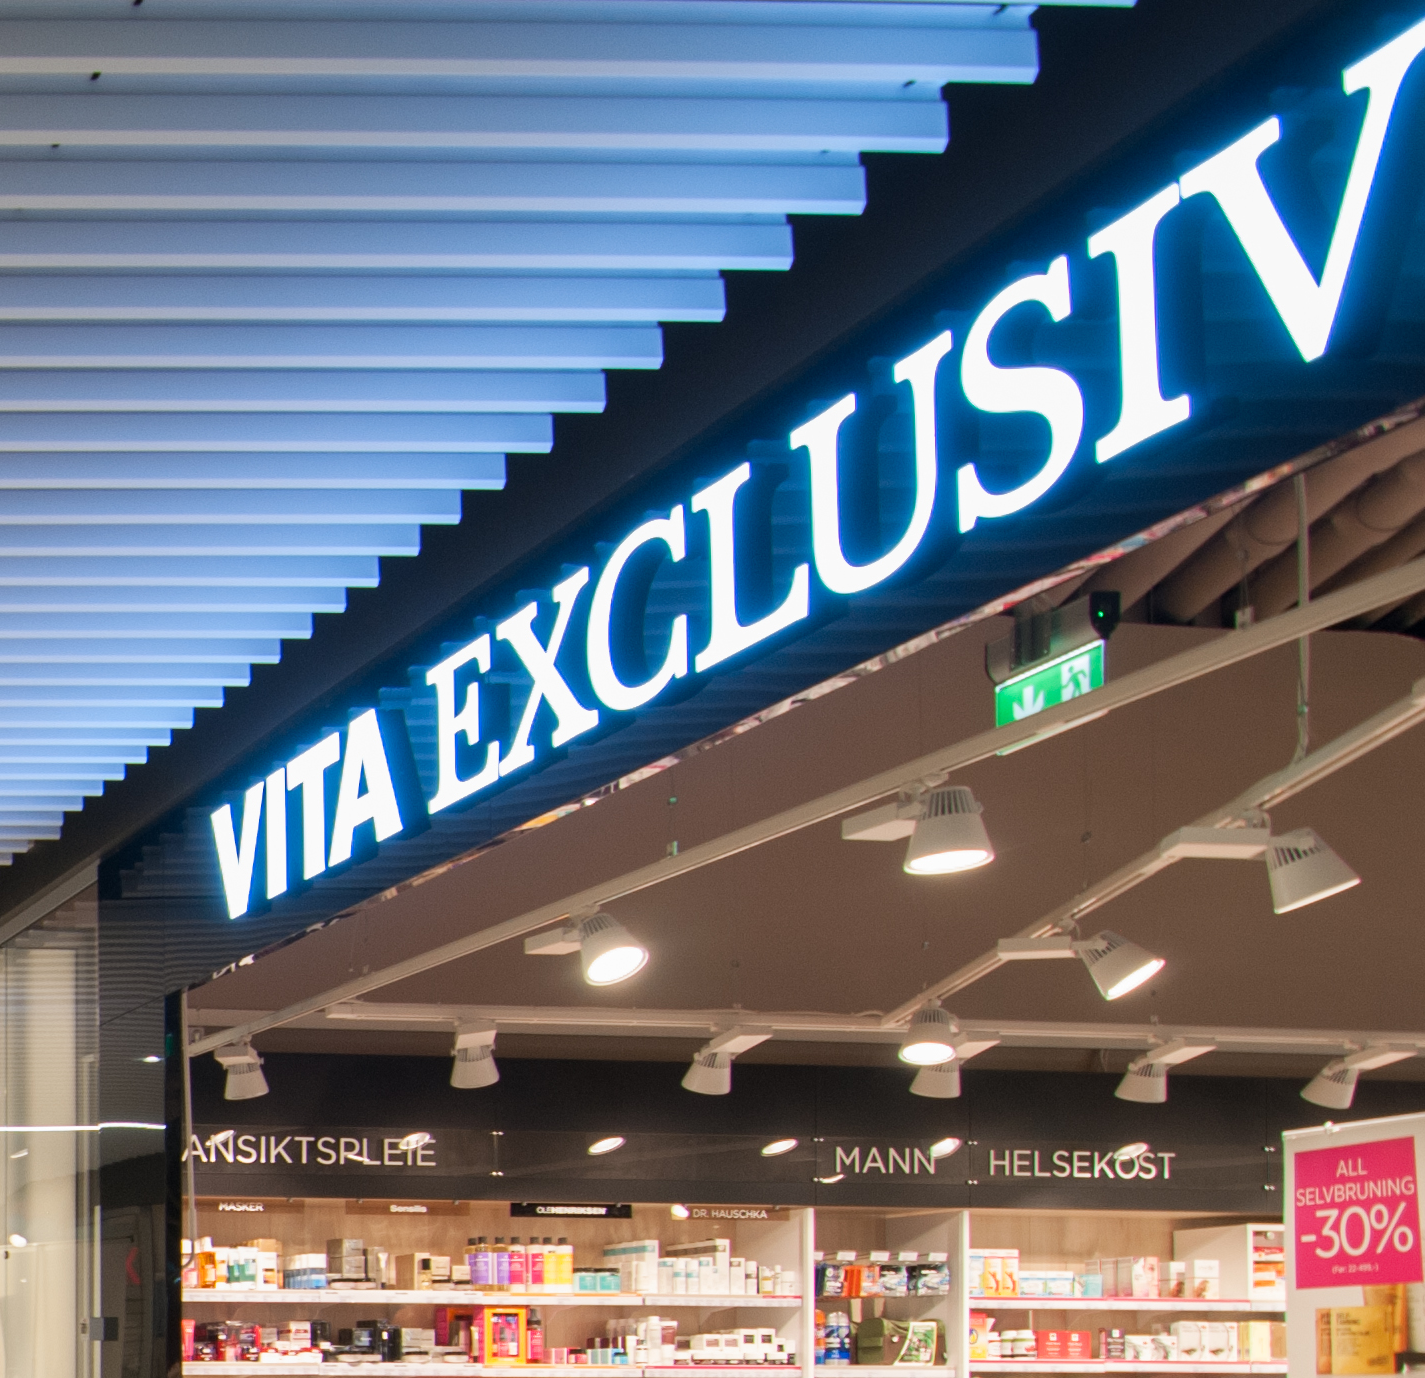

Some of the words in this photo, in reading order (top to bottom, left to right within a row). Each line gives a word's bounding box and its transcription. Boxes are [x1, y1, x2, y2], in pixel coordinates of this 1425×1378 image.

[211, 708, 404, 920] VITA
[425, 19, 1425, 815] EXCLUSIV
[835, 1146, 936, 1174] MANN
[989, 1149, 1176, 1180] HELSEKOST
[1336, 1157, 1368, 1178] ALL
[1296, 1175, 1415, 1207] SELVBRUNING
[219, 1202, 264, 1212] MASKER
[693, 1209, 709, 1218] DR.
[712, 1210, 768, 1219] HAUSCHKA
[1301, 1202, 1414, 1259] -30%
